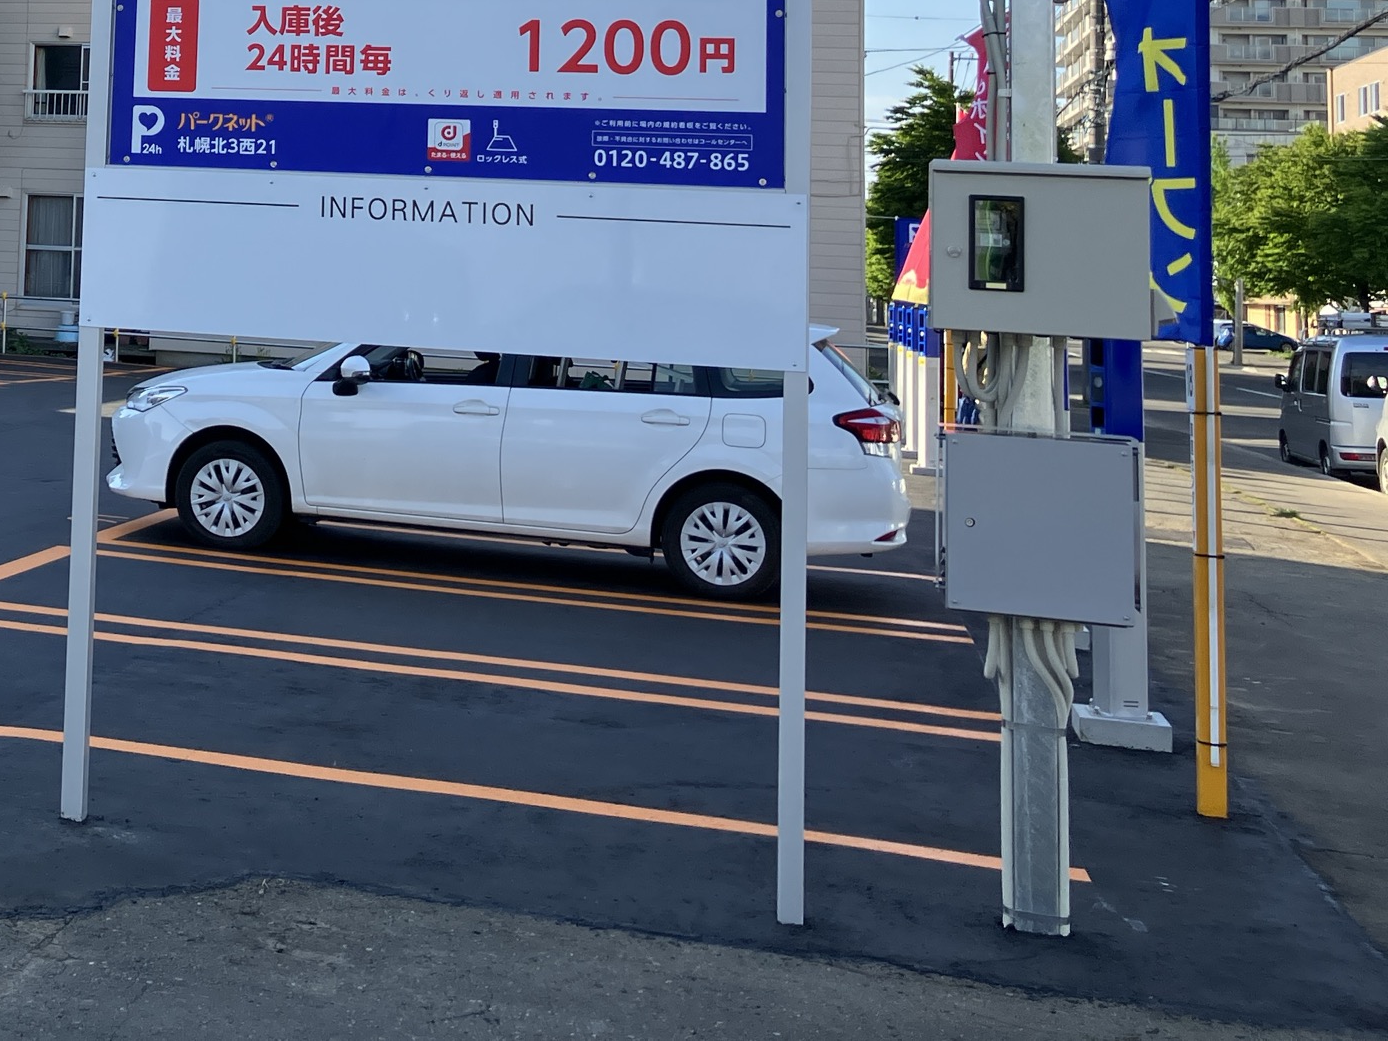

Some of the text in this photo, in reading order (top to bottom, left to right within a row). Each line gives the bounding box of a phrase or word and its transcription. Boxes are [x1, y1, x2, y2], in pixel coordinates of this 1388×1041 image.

[246, 5, 345, 37] 入庫後
[163, 6, 183, 81] 最大料金
[245, 43, 392, 76] 24時間毎
[518, 19, 736, 76] 1200円
[142, 143, 162, 154] 24h
[177, 136, 276, 155] 札幌北3西21
[476, 155, 528, 165] ロックレス式
[594, 149, 750, 171] 0120-487-865
[319, 195, 535, 227] INFORMATION
